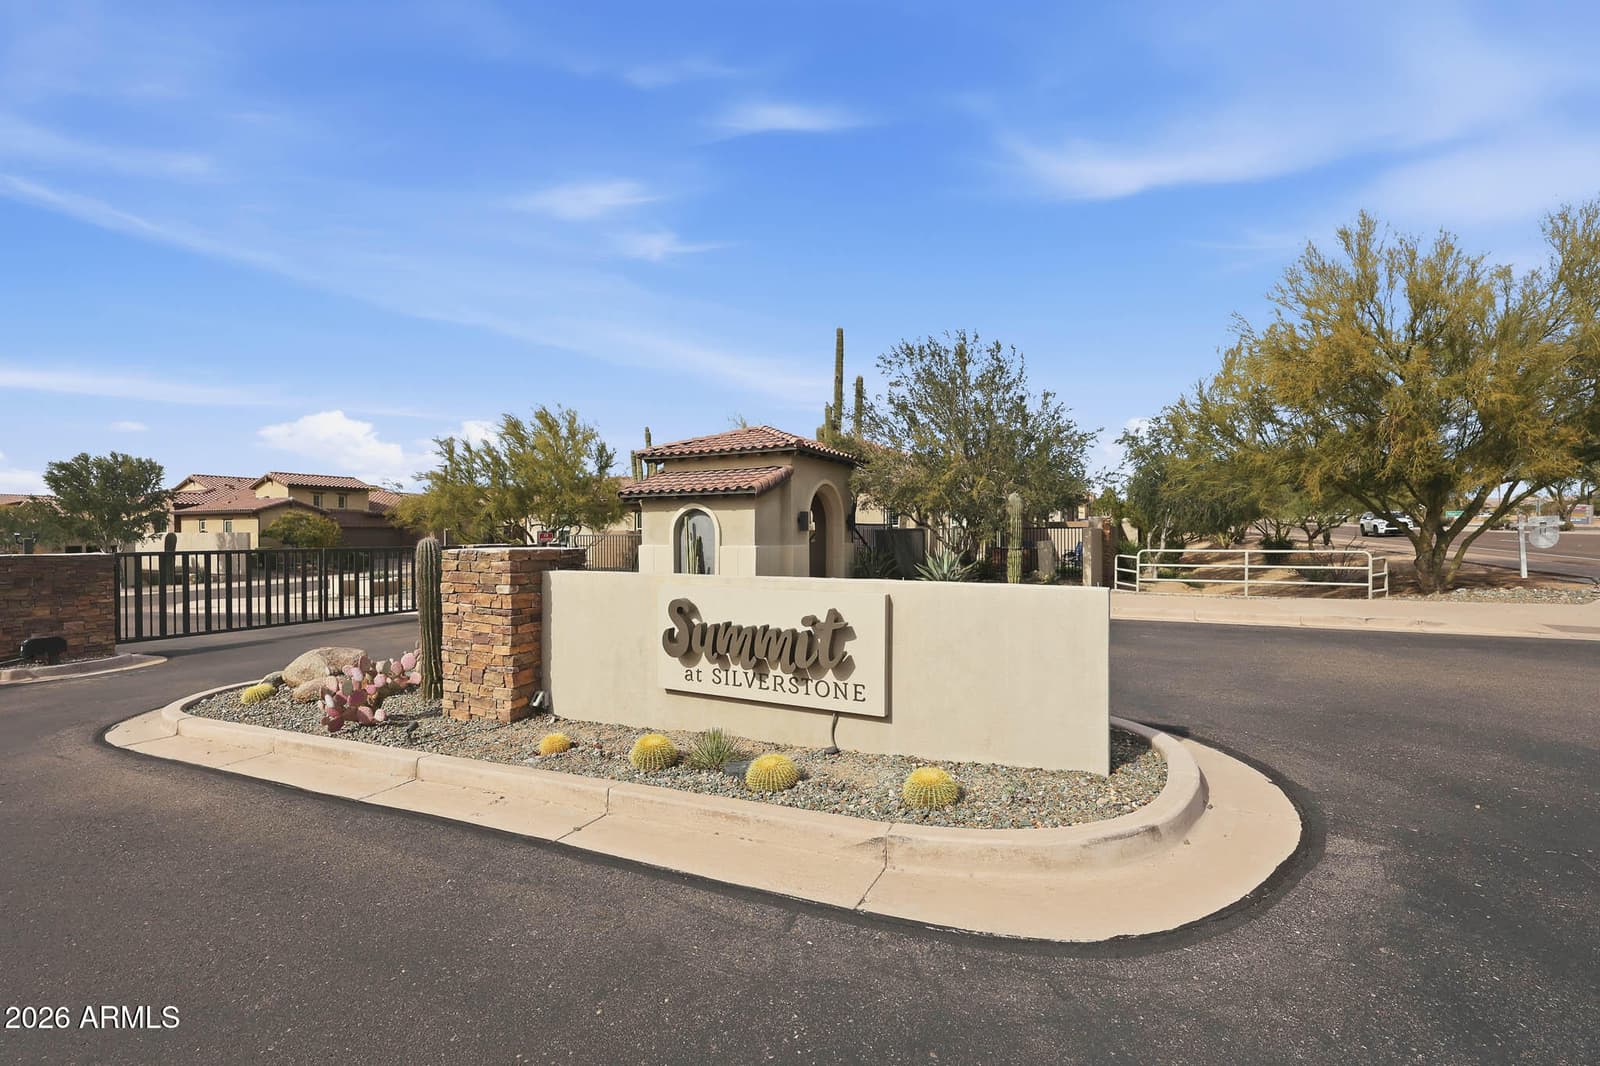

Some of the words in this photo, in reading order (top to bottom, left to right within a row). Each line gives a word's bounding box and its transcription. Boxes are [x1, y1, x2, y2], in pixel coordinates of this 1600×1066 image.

[662, 598, 853, 675] Summit
[684, 668, 702, 683] at
[711, 668, 867, 702] SILVERSTONE
